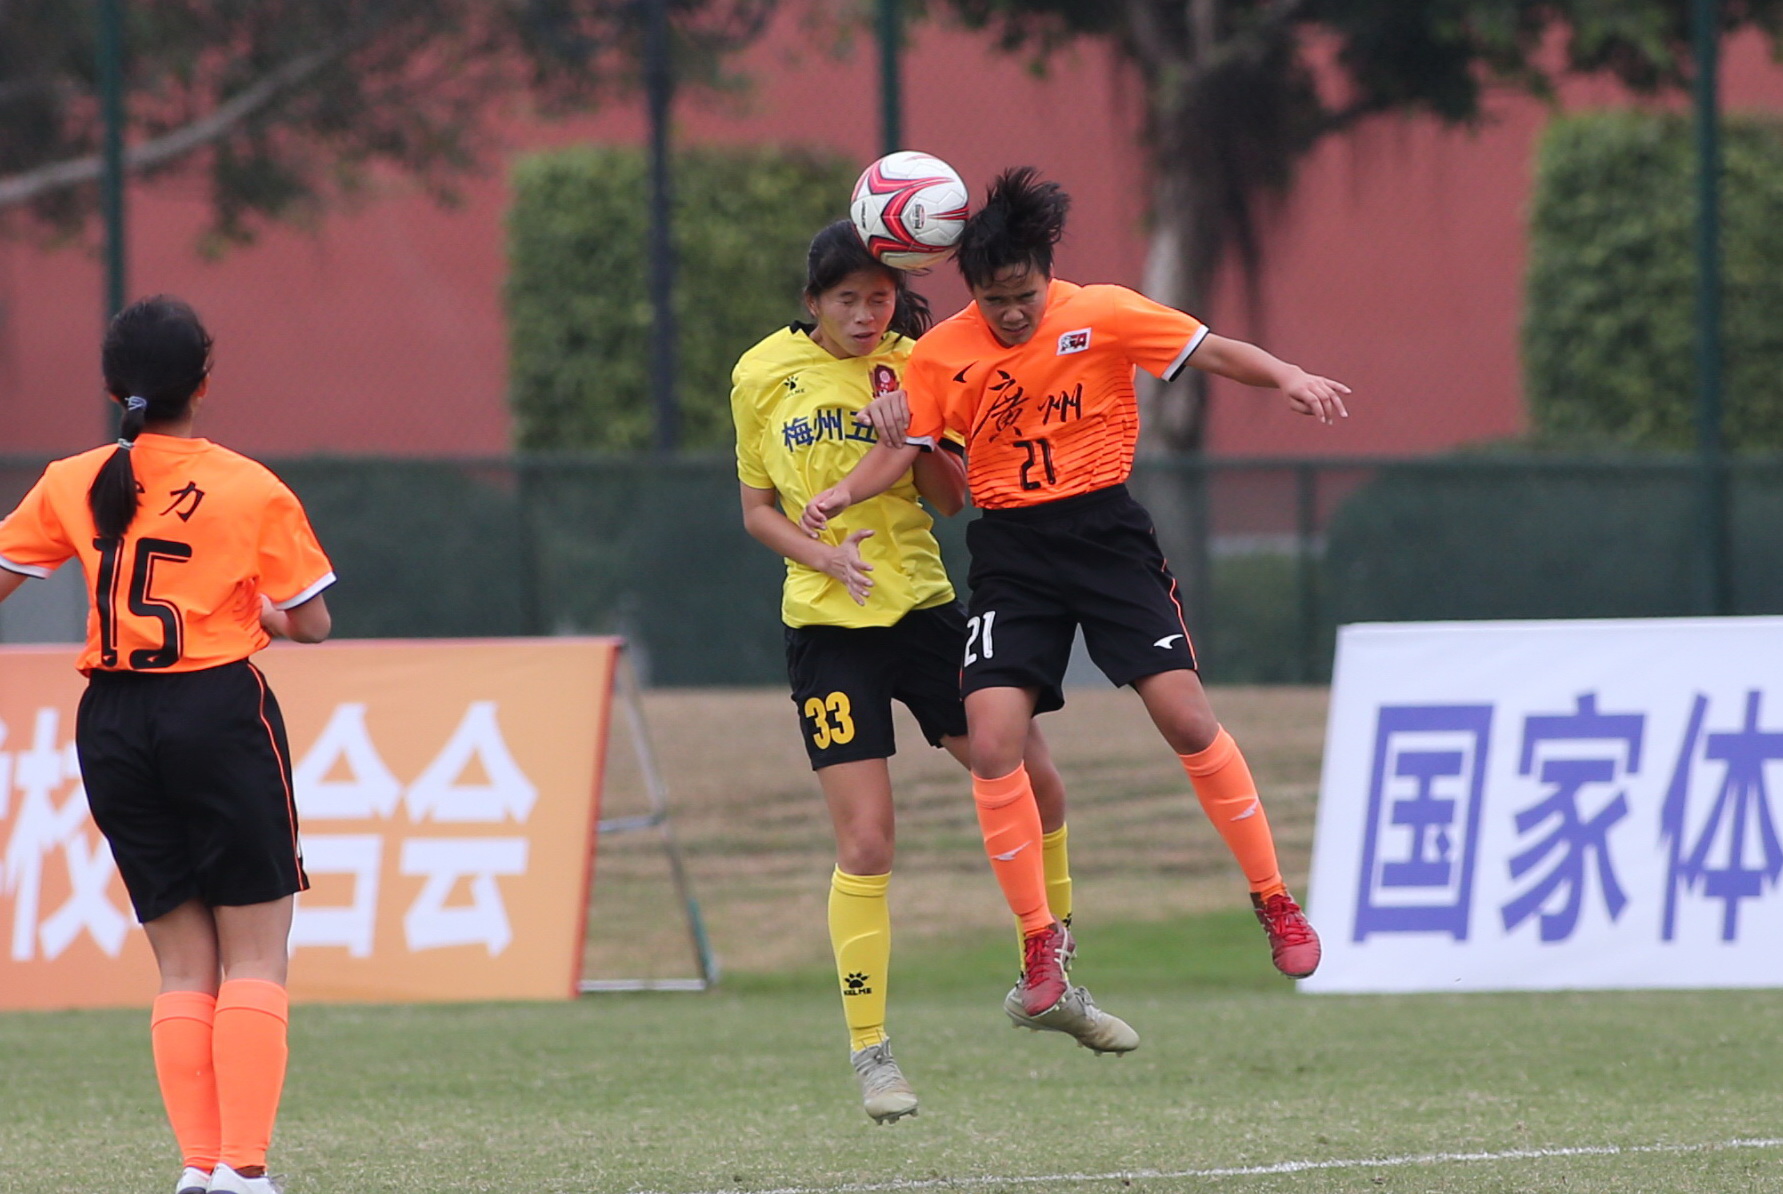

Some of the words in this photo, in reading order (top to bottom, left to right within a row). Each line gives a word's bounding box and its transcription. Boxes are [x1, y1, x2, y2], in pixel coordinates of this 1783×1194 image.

[1013, 438, 1056, 490] 21
[137, 480, 205, 522] 力
[93, 537, 193, 670] 15
[964, 611, 996, 667] 21
[804, 691, 855, 749] 33
[1352, 690, 1783, 941] 国家体
